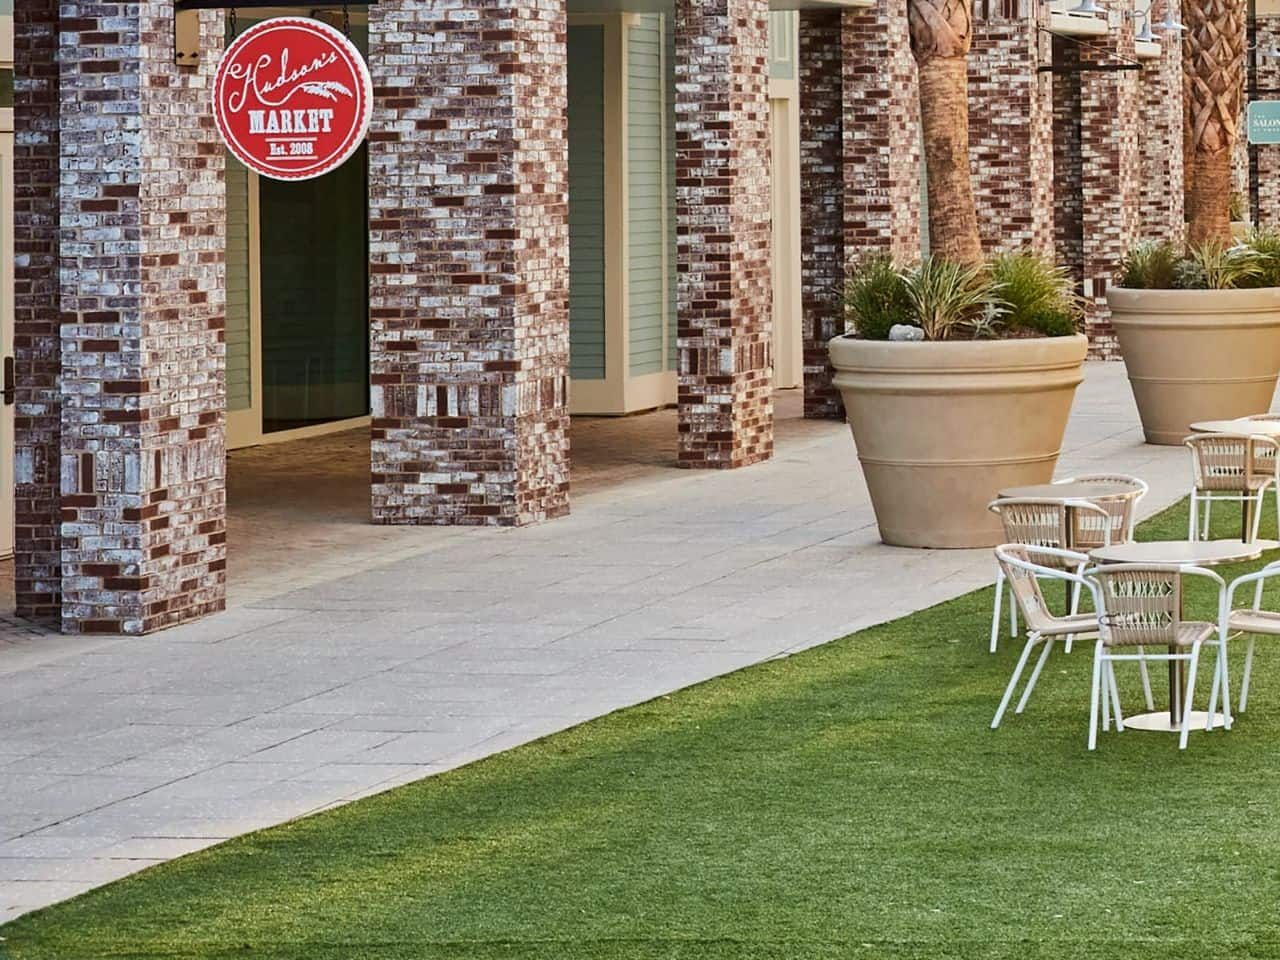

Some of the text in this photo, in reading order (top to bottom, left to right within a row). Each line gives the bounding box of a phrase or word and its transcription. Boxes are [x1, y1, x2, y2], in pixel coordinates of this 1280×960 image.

[228, 47, 339, 113] Hudson's
[248, 108, 335, 134] MARKET
[269, 143, 289, 156] Est.
